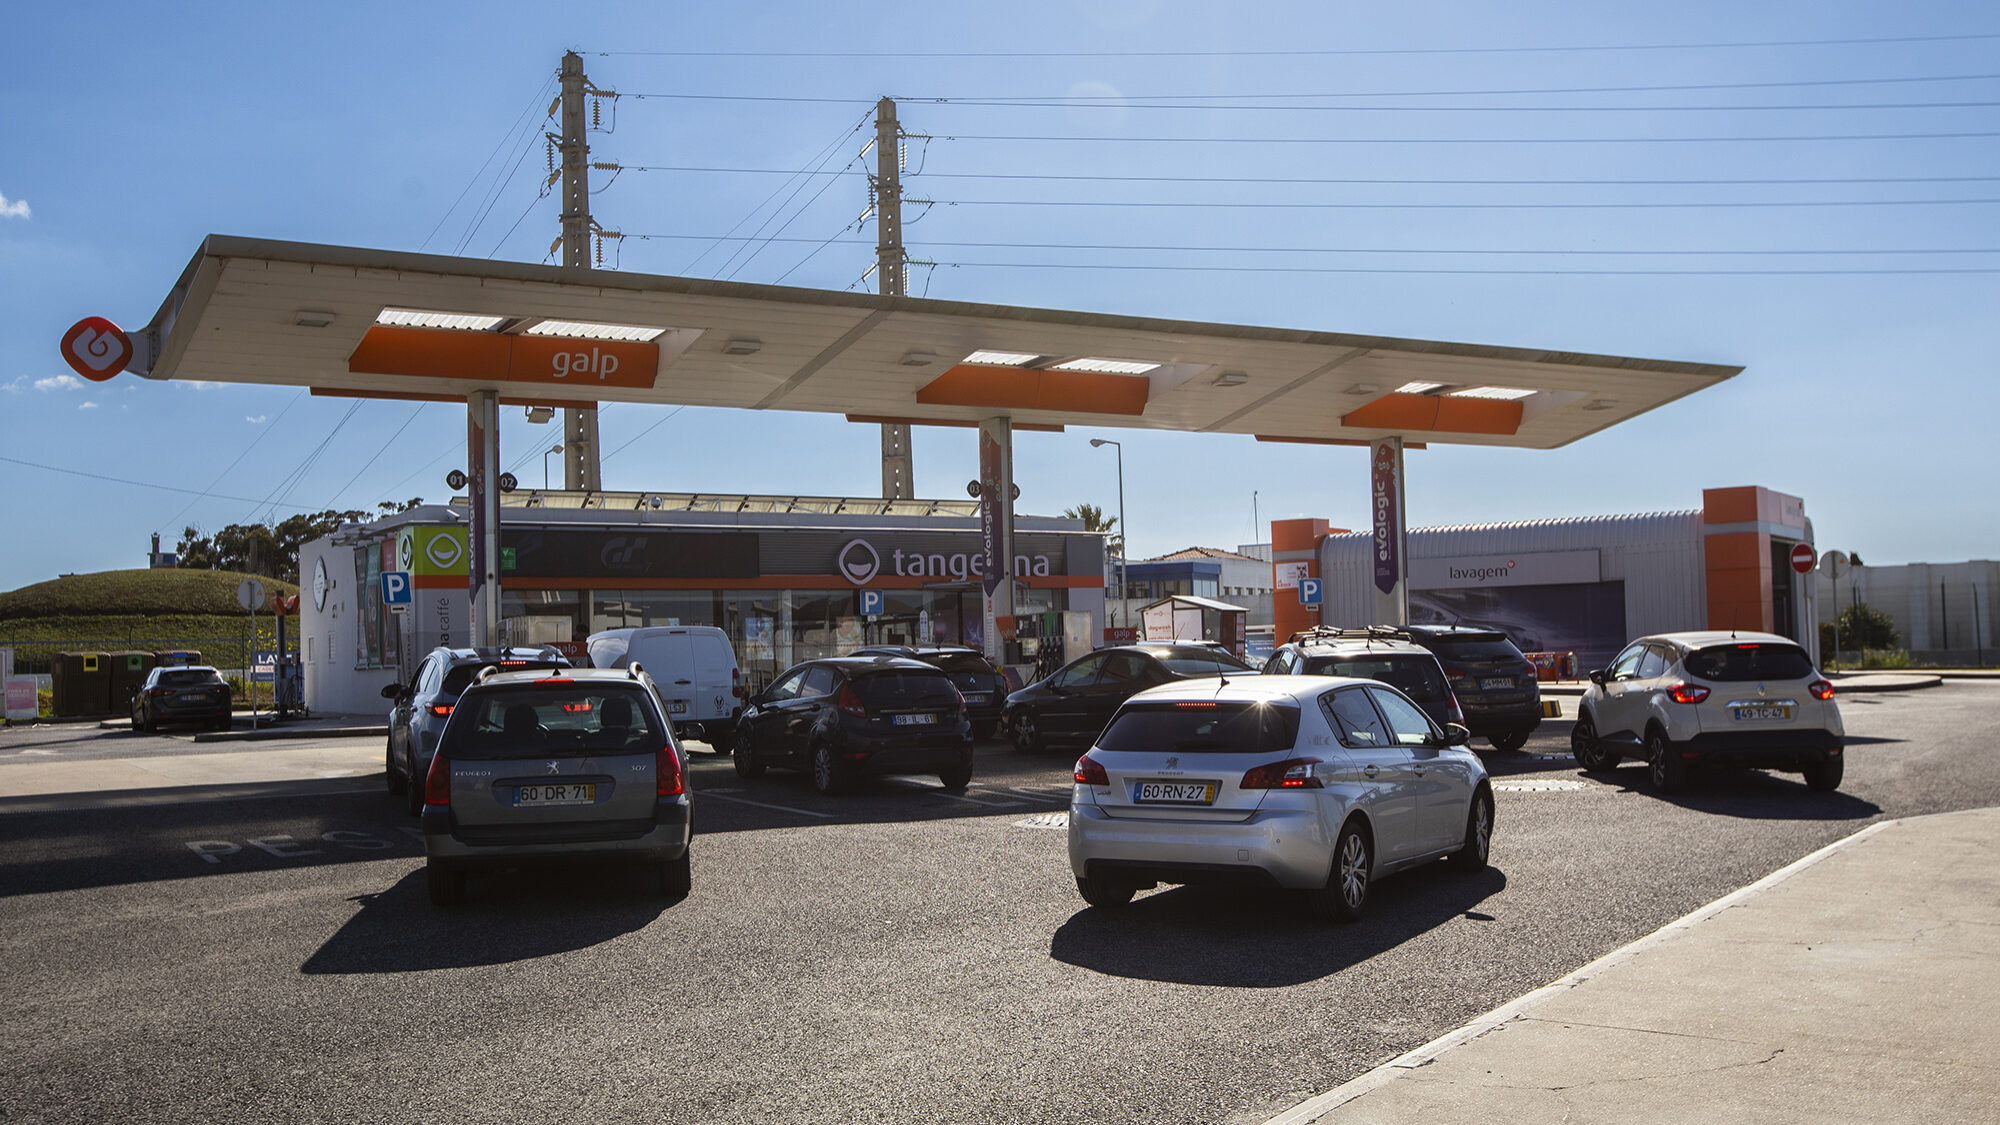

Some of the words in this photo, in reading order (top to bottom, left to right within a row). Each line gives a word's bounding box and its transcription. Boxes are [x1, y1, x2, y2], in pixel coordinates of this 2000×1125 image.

[552, 347, 619, 380] galp
[450, 475, 463, 486] 01
[501, 477, 516, 489] 02
[969, 484, 980, 495] 03
[1375, 480, 1390, 562] evologic
[984, 501, 993, 568] evologic
[892, 548, 1049, 583] tangena
[1449, 567, 1508, 582] lavagem
[387, 574, 405, 602] P
[1303, 581, 1318, 602] P
[865, 591, 879, 613] P
[1113, 629, 1130, 640] galp
[521, 785, 587, 801] 60·DR·71
[1143, 784, 1205, 799] 60·RN·27
